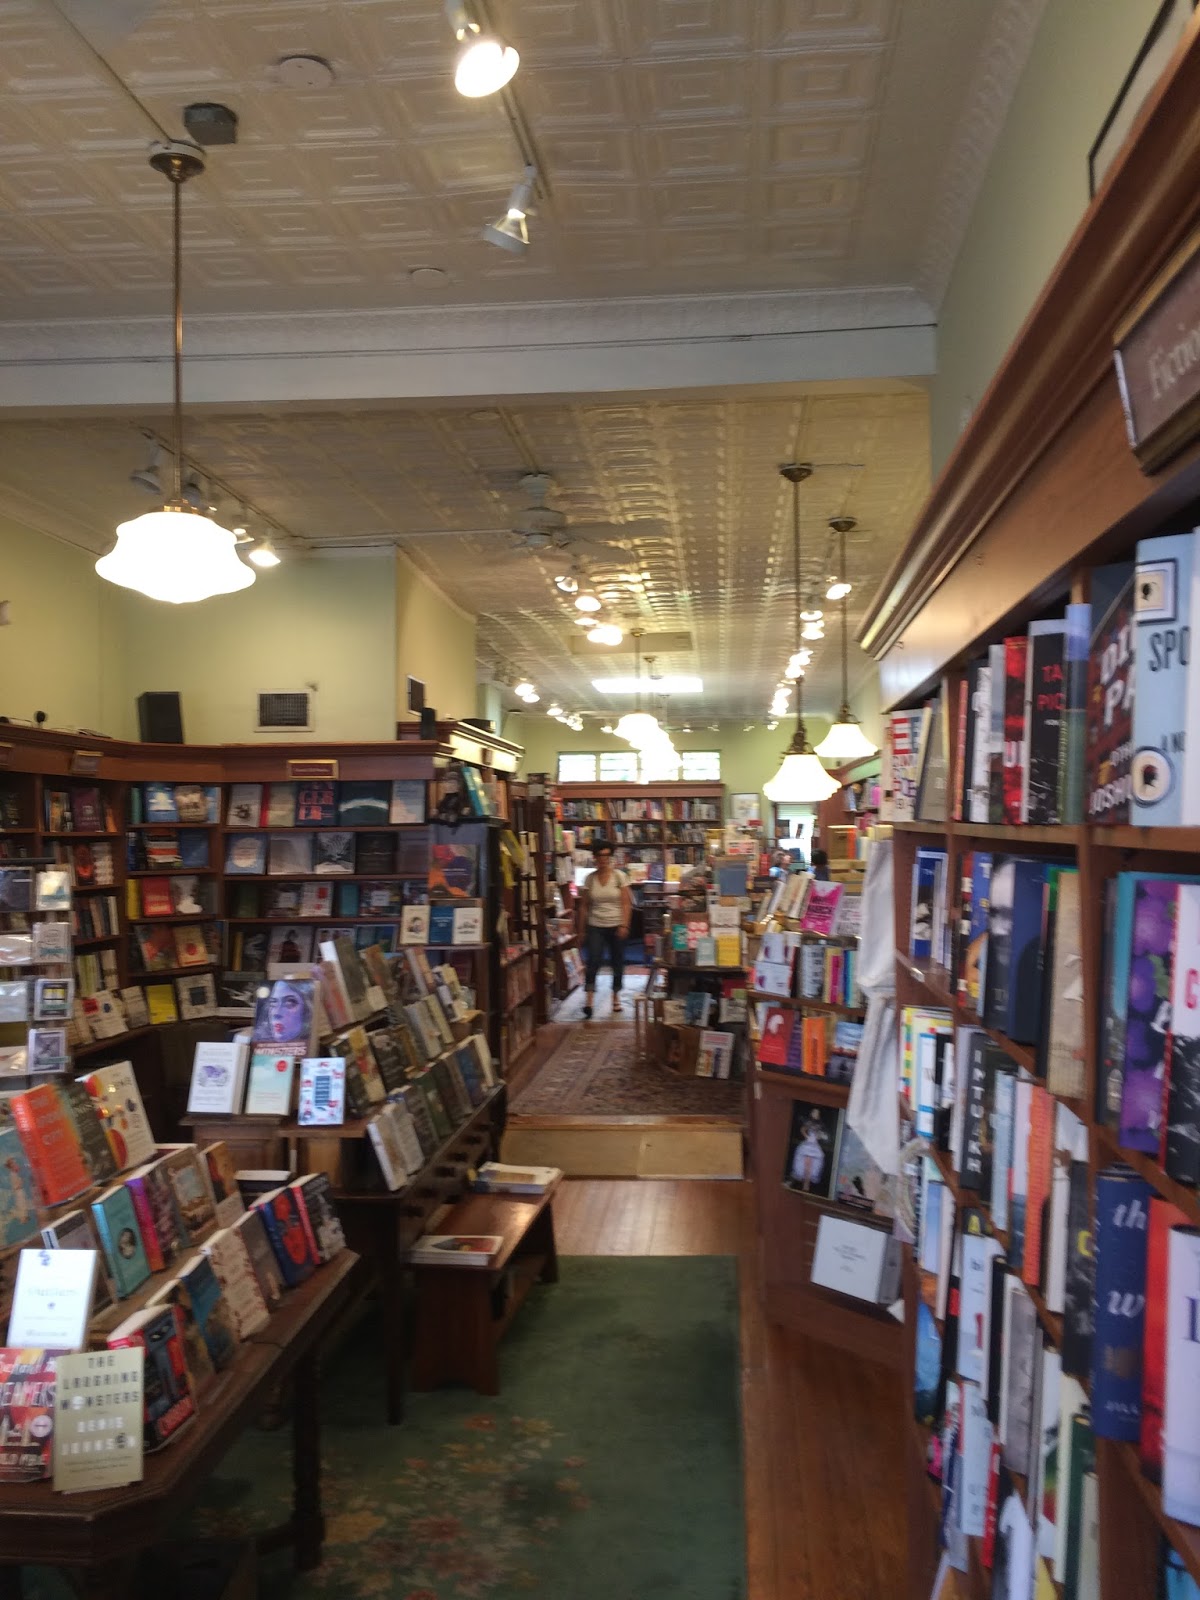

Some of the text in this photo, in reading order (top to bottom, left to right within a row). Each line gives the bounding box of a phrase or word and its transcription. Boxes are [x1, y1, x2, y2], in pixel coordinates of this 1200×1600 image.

[88, 1355, 115, 1371] THE
[63, 1371, 139, 1390] LAUGHING
[60, 1391, 140, 1411] MONSTERS
[77, 1416, 124, 1433] DENIS
